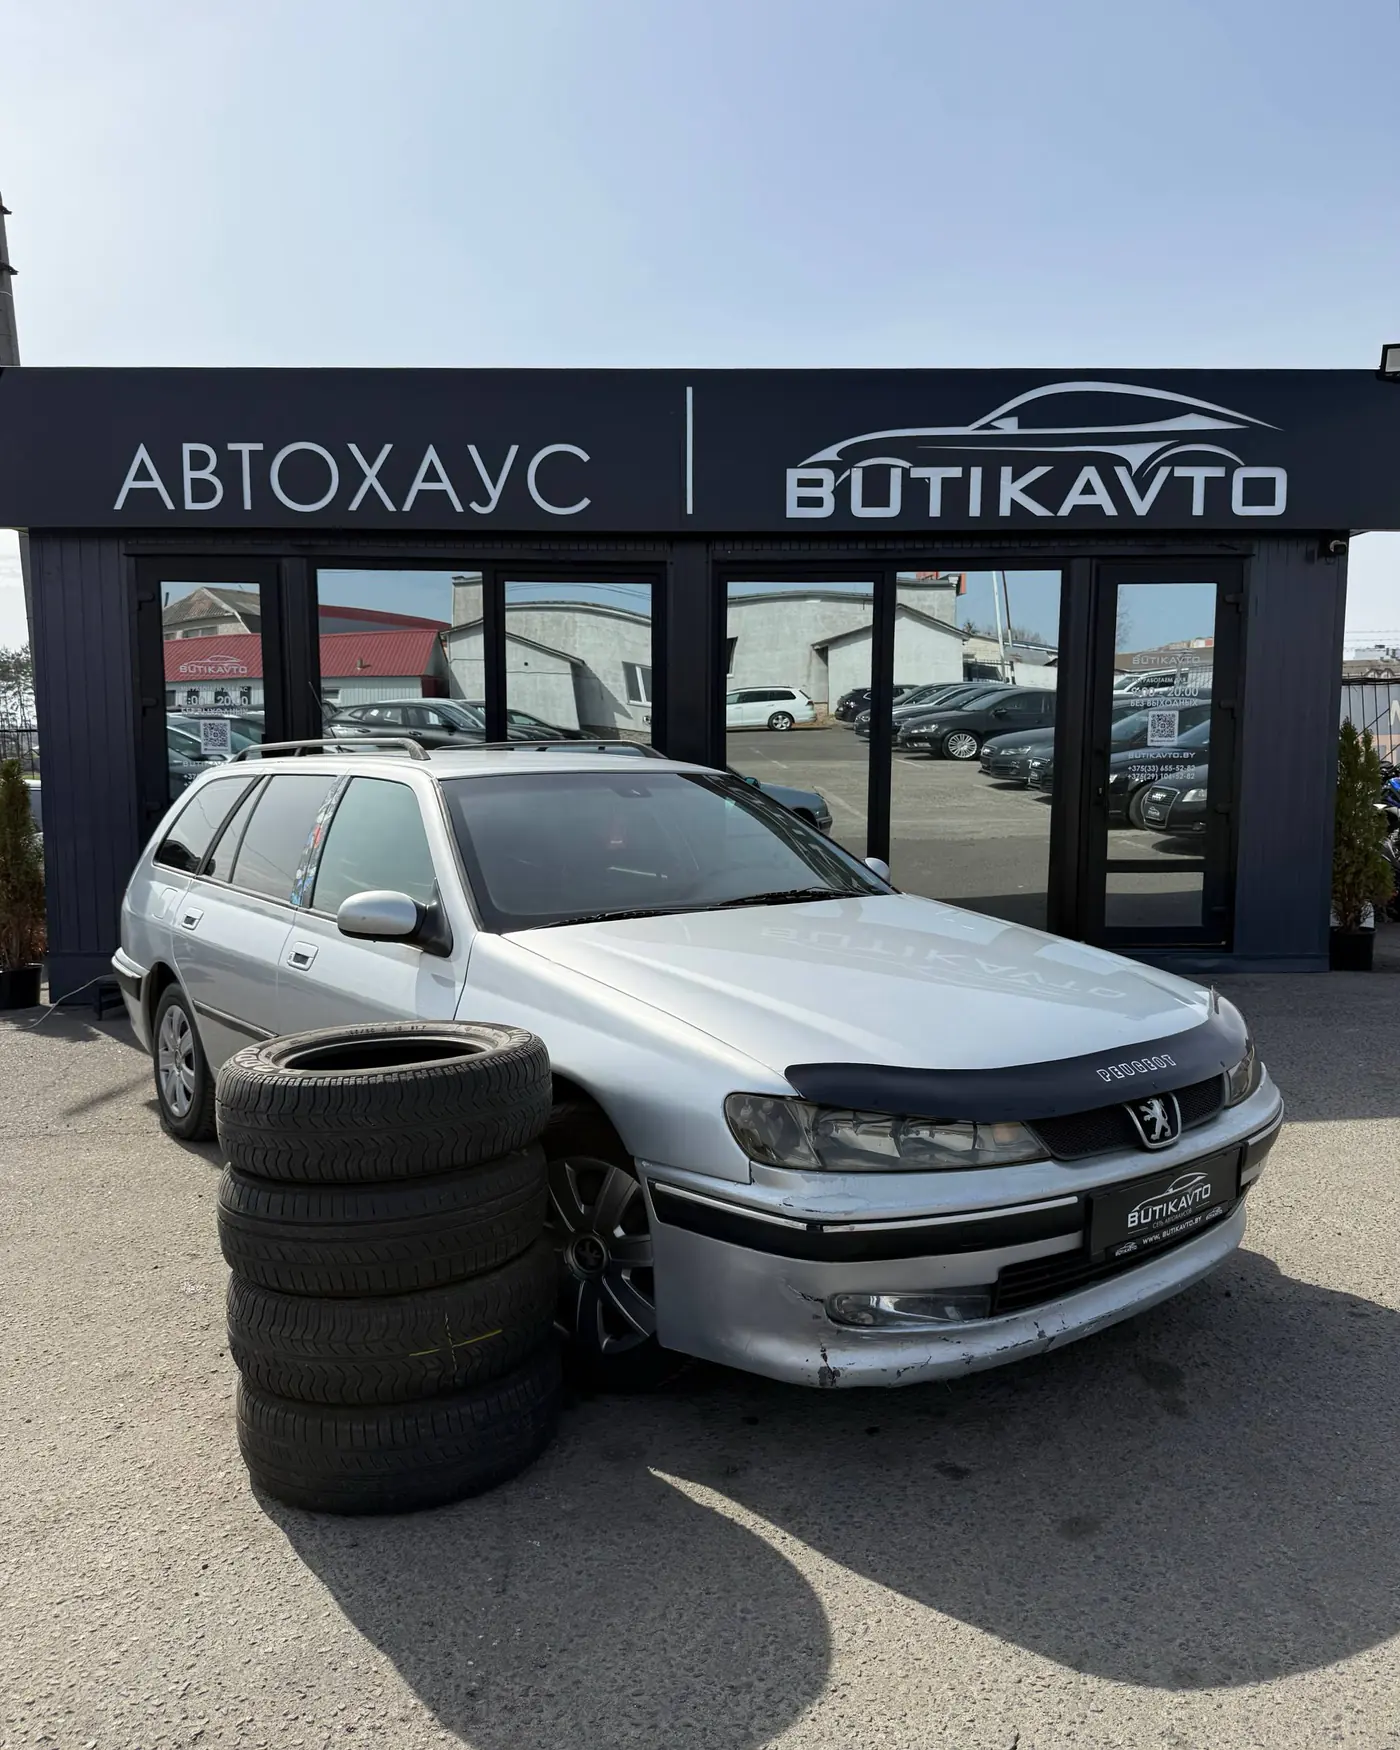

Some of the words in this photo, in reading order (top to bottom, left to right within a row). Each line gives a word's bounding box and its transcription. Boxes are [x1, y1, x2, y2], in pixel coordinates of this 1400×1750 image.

[113, 441, 591, 515] АВТОХАУС
[786, 466, 1288, 518] BUTIKAVTO
[1132, 656, 1200, 665] BUTIKAVTO
[179, 664, 248, 674] BUTIKAVTO
[1167, 687, 1199, 697] 20:00
[1130, 699, 1145, 707] БЕЗ
[1147, 699, 1198, 707] ВЫХОДНЫХ
[1128, 765, 1159, 773] +375(33)
[1096, 1054, 1177, 1082] PEUGEOT
[1127, 1183, 1211, 1228] BUTIKAVTO
